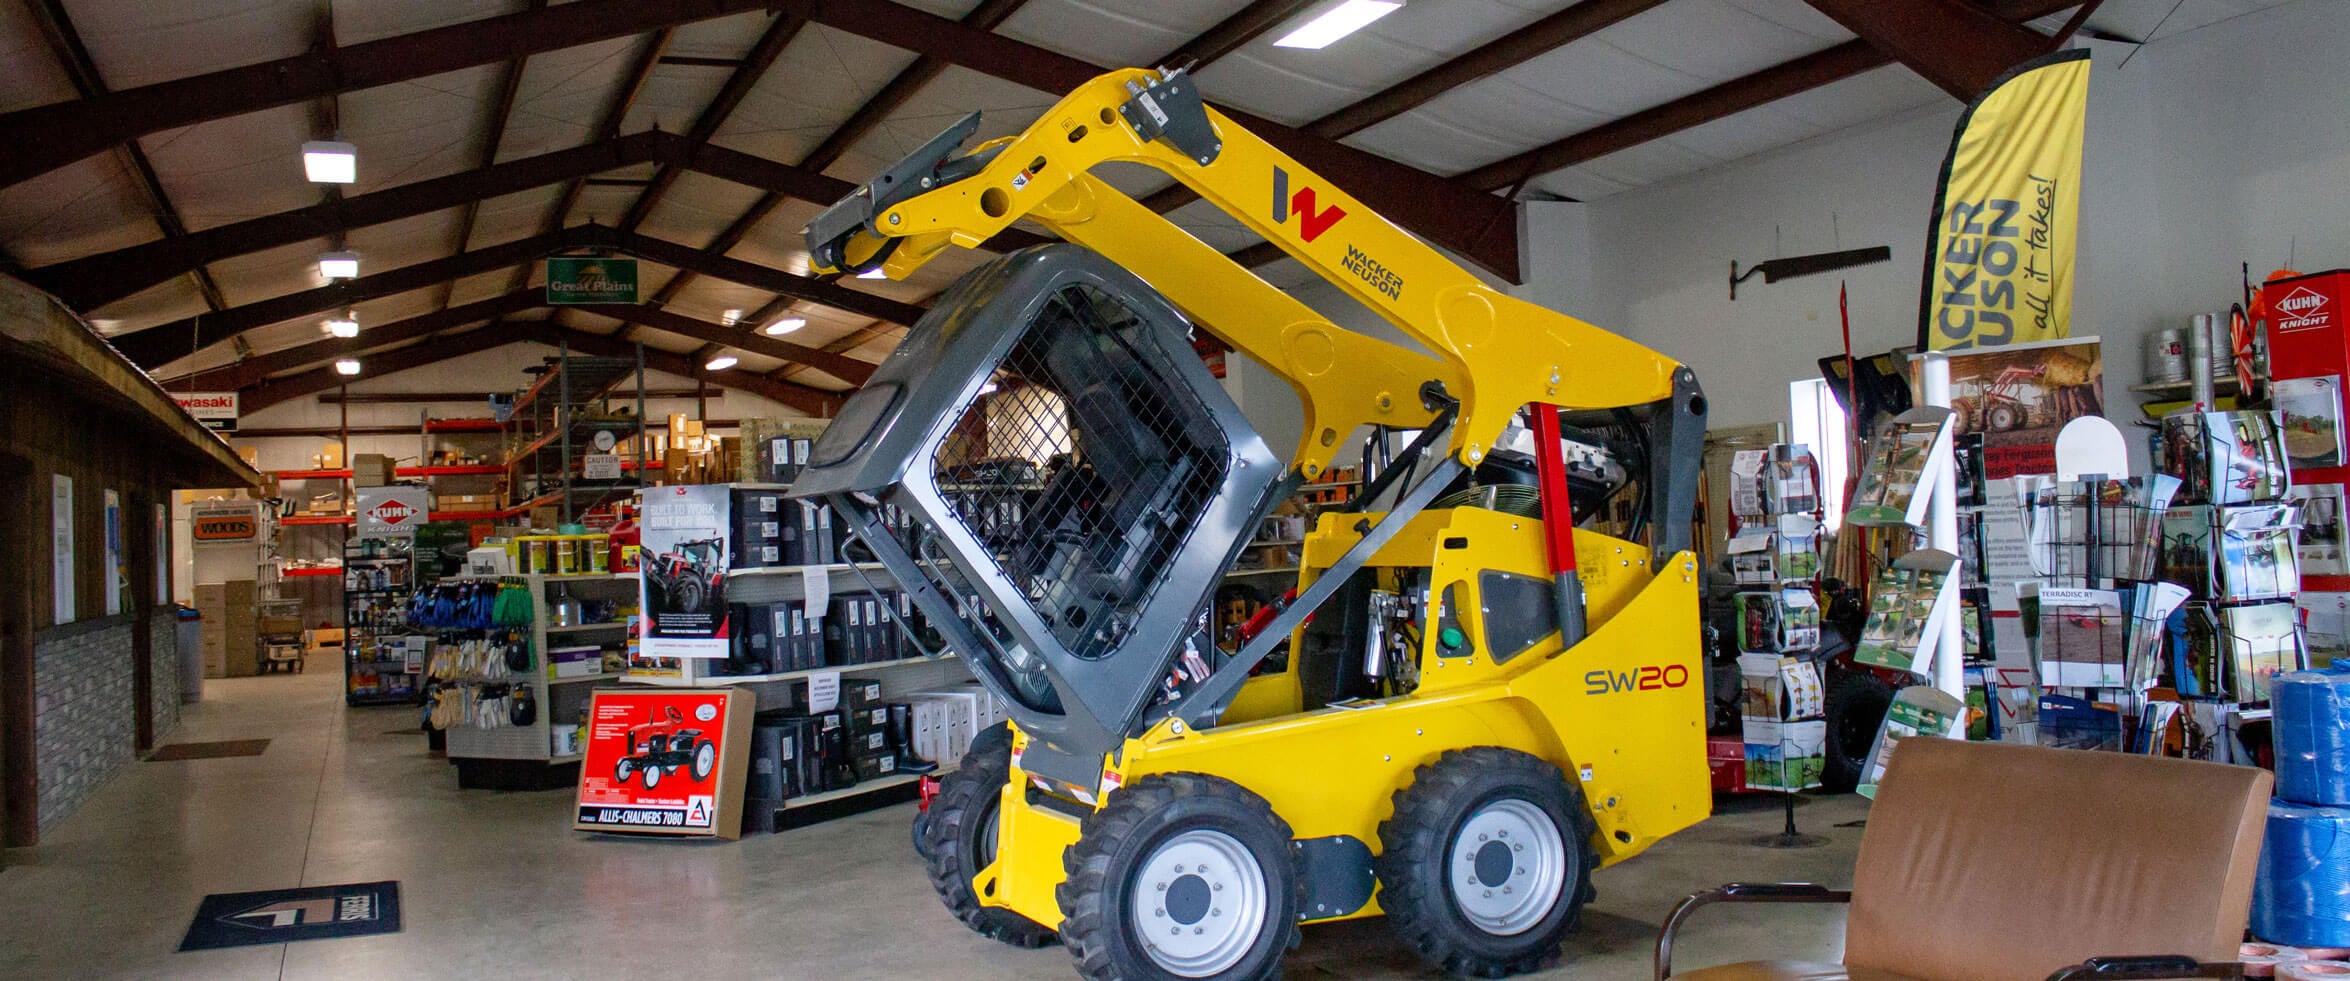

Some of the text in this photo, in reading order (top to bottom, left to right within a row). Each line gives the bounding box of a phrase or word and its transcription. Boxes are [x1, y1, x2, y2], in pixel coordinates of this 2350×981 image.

[2024, 174, 2053, 329] all it takes!
[1341, 255, 1400, 302] NEUSON
[1348, 243, 1404, 290] WACKER
[1937, 200, 1985, 352] CKER
[1977, 199, 2020, 350] USON
[2282, 295, 2321, 311] KUHN
[2280, 315, 2328, 329] KNIGHT
[175, 396, 233, 407] wasaki
[373, 506, 412, 518] KUHN
[201, 522, 249, 533] WOODS
[1584, 664, 1688, 695] SW20
[598, 808, 684, 826] ALLIS-CHALMERS 7080
